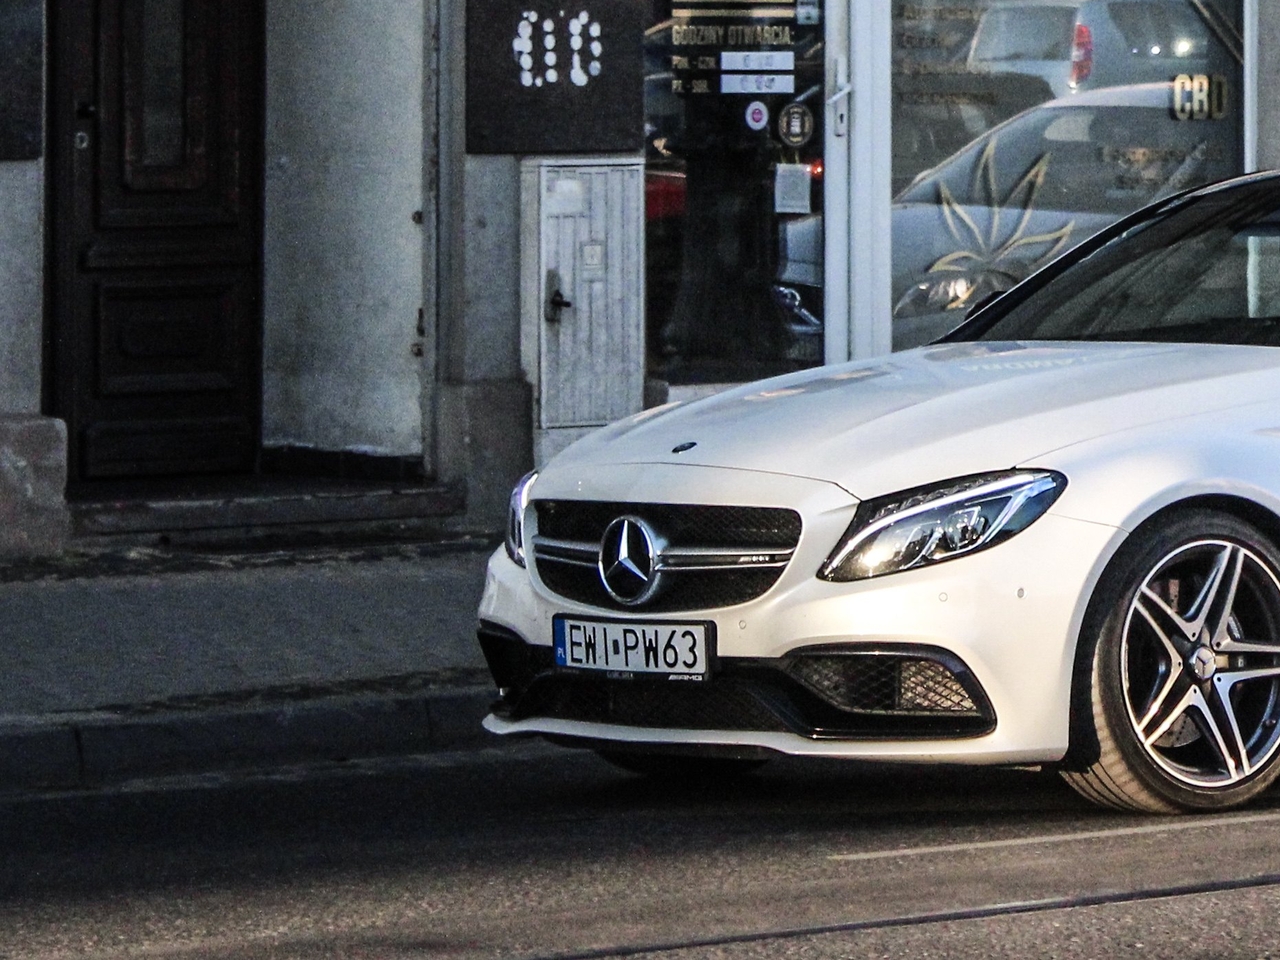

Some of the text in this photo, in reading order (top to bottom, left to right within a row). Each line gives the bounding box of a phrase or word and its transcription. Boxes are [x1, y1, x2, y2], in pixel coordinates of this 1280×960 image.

[1174, 73, 1229, 121] CBD
[569, 624, 698, 669] EWI PW63
